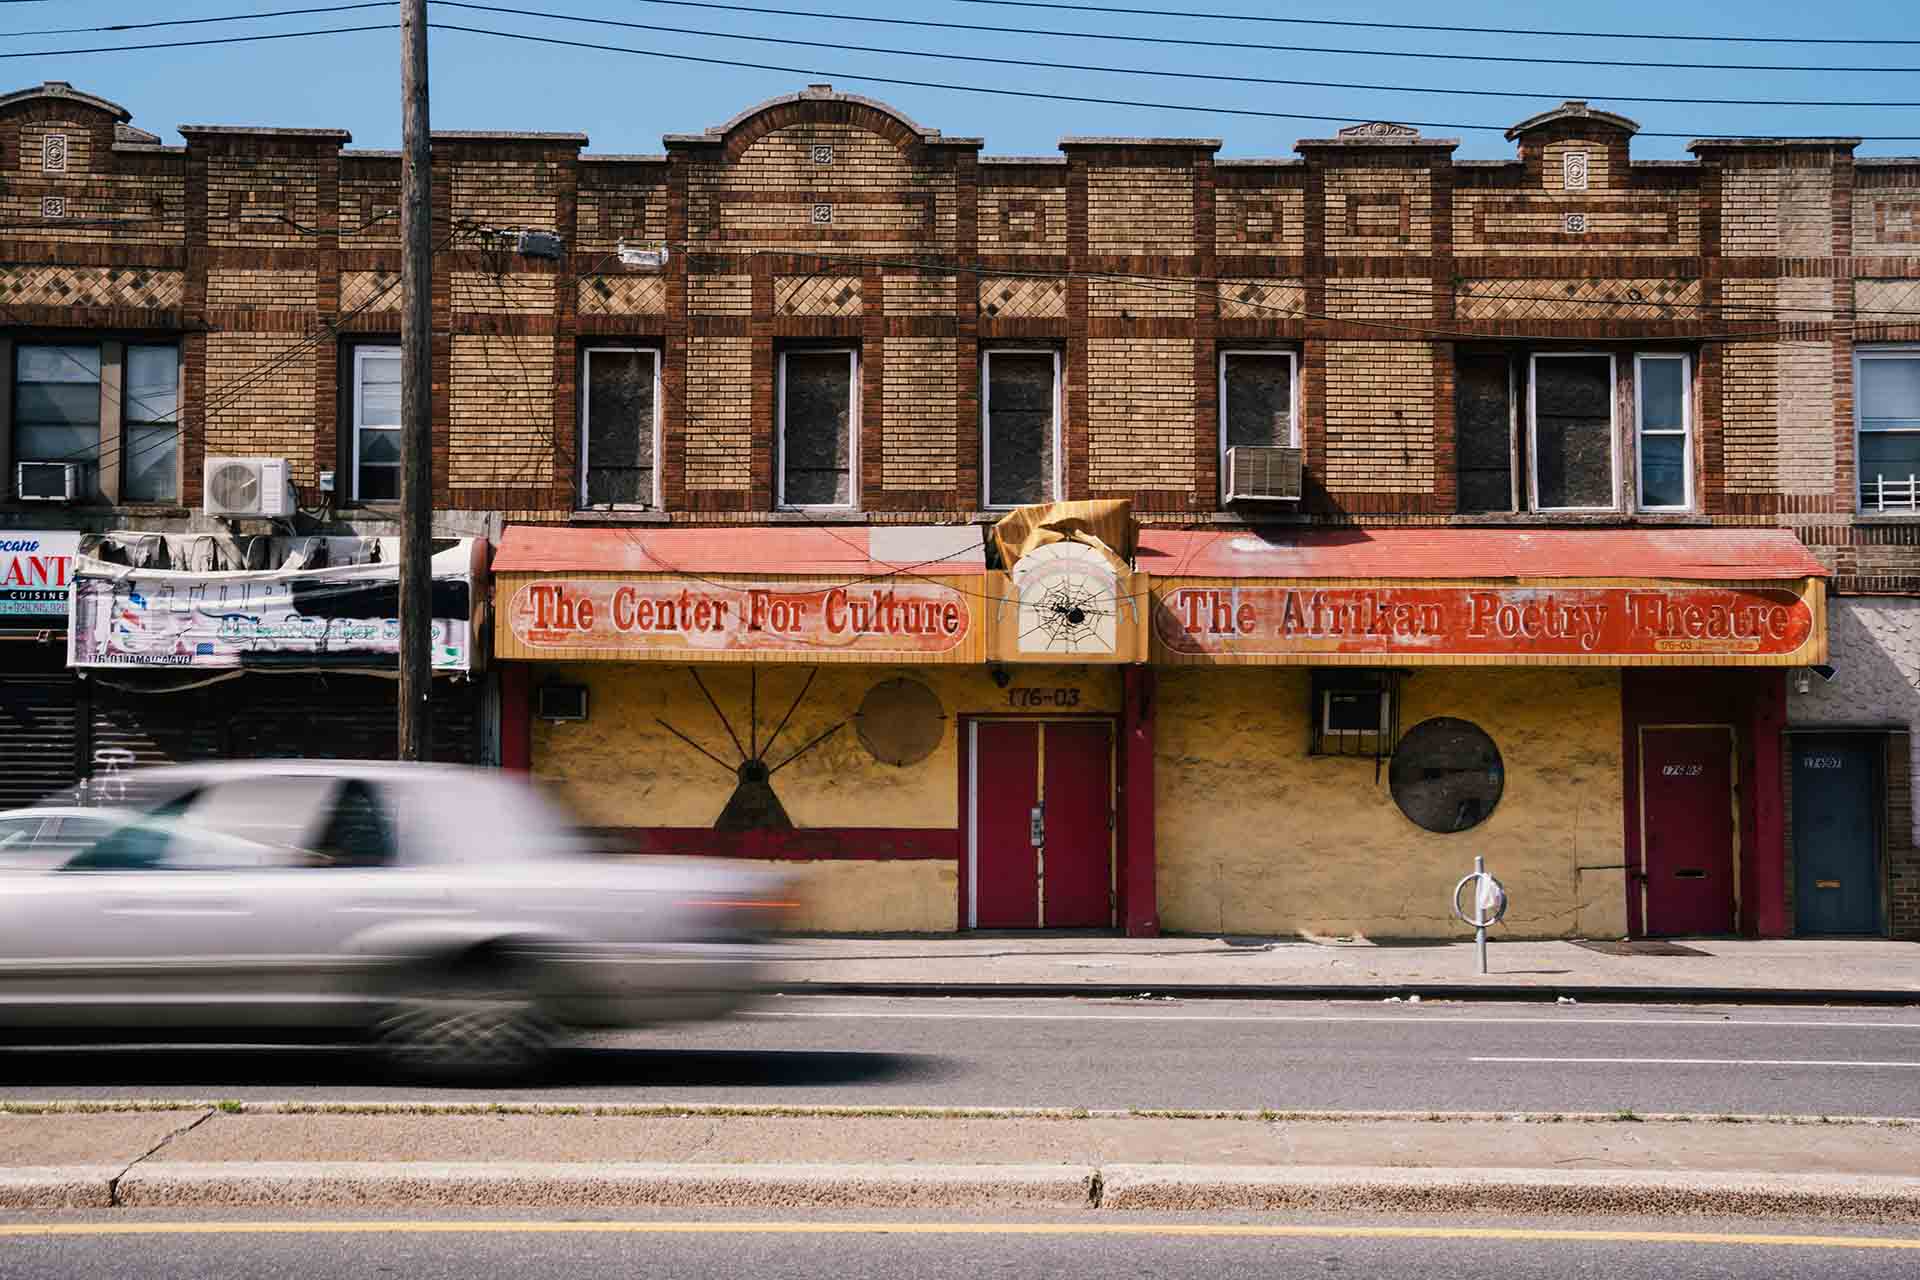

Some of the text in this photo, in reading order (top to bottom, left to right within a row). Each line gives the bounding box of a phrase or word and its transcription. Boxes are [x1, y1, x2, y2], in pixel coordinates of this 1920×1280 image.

[10, 591, 65, 600] CUISINE
[529, 585, 960, 634] The Center For Culture
[1178, 589, 1790, 650] The Afrikan Poetry Theatre
[1008, 687, 1081, 706] 176-03
